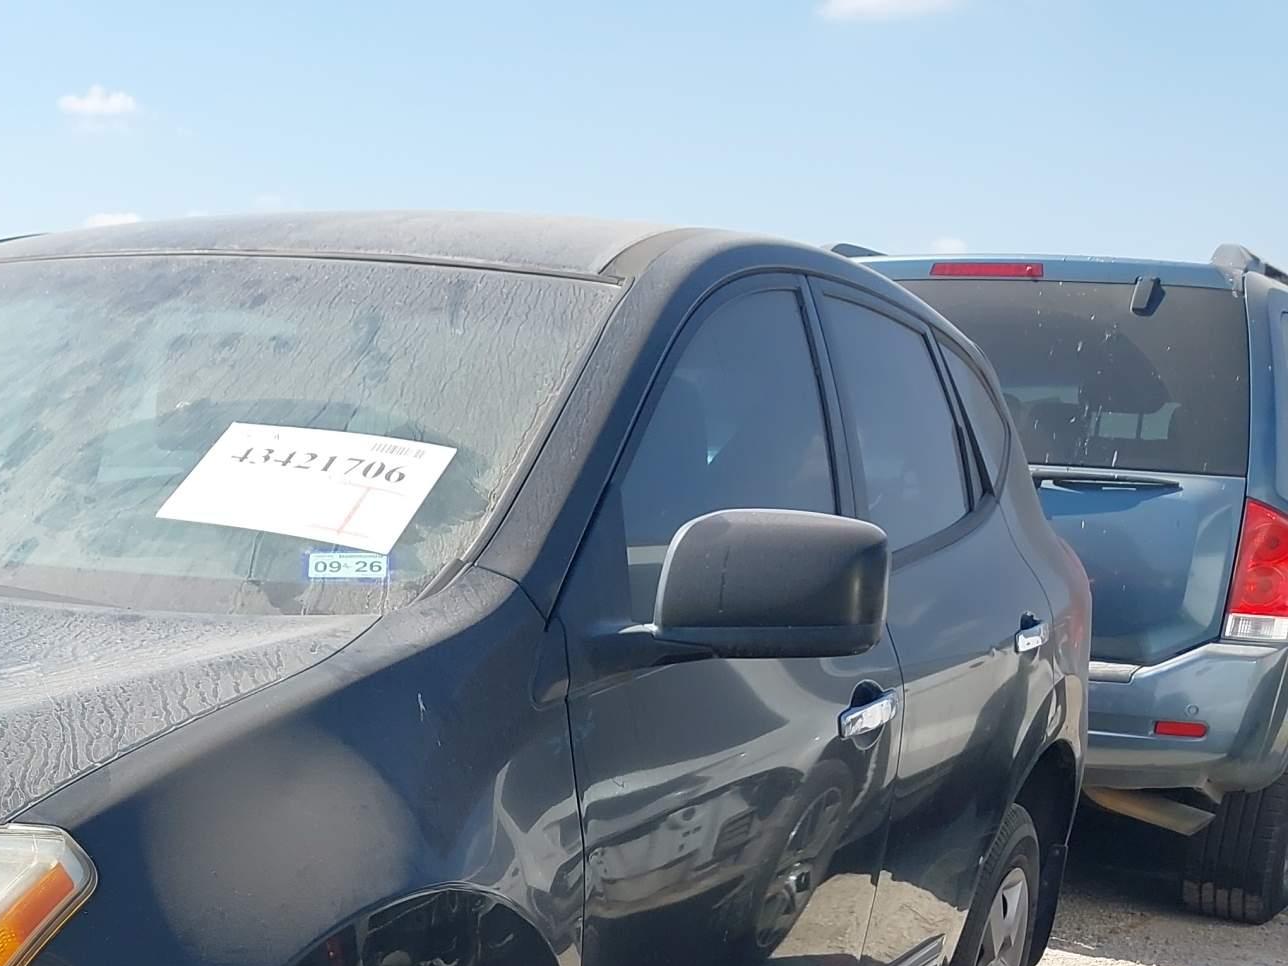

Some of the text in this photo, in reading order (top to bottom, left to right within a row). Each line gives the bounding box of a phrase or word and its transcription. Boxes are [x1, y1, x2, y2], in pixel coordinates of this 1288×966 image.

[230, 447, 406, 483] 43421706
[314, 560, 383, 573] 09 26
